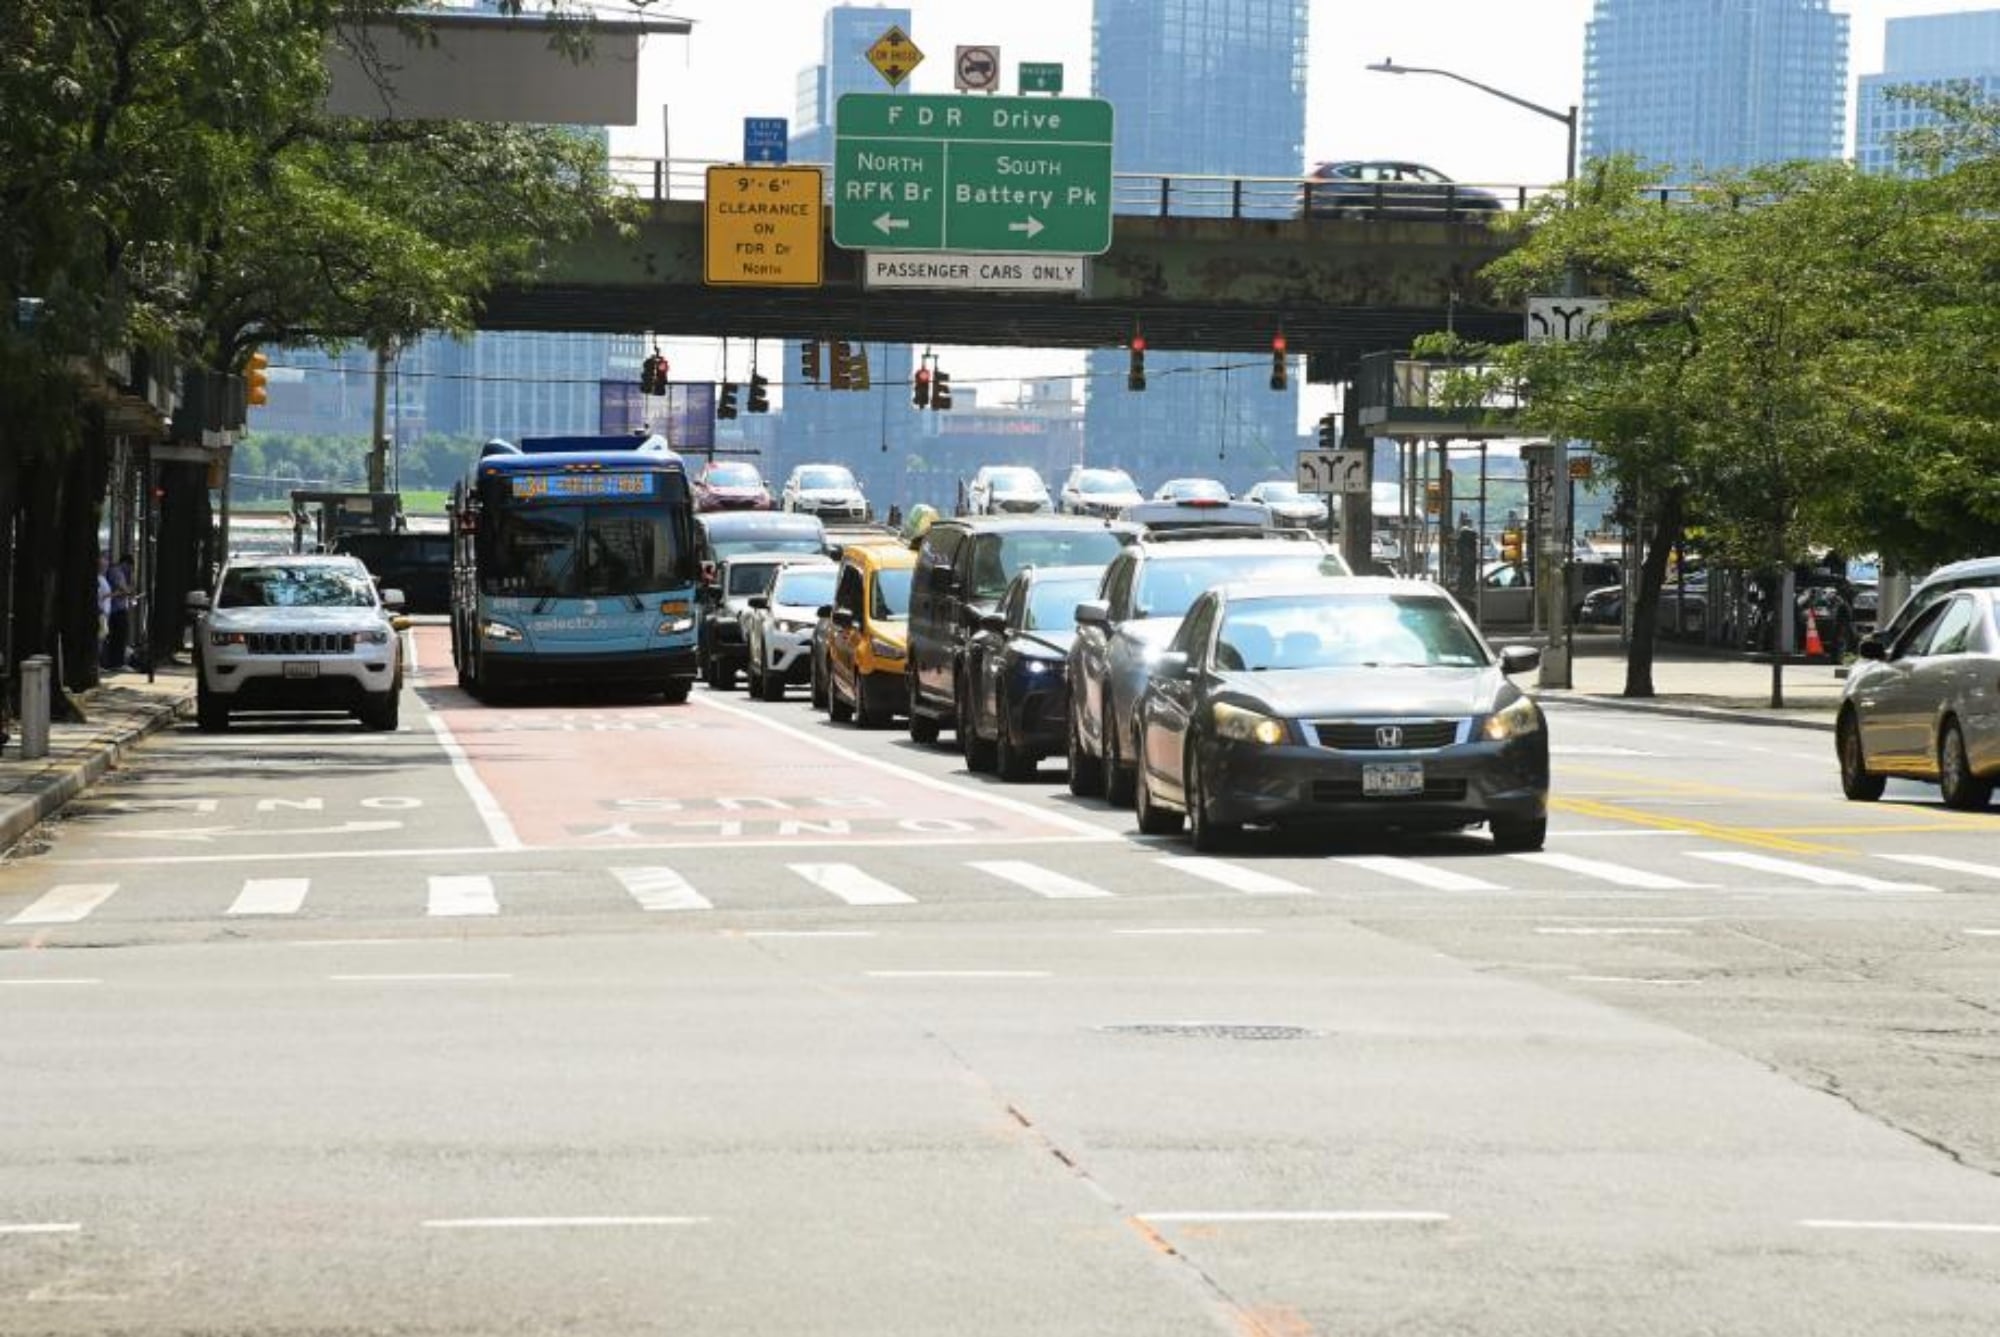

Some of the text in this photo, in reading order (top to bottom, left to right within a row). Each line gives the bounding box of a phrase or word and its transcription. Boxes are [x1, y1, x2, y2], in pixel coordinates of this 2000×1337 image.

[993, 110, 1061, 129] Drive
[857, 152, 923, 172] NORTH
[997, 157, 1061, 175] SOUTH
[846, 182, 932, 201] RFK Br
[956, 184, 1097, 209] Battery Pk
[719, 202, 809, 216] CLEARANCE
[753, 223, 775, 235] ON
[736, 242, 791, 255] FDR Dr
[877, 262, 1075, 280] PASSENGER CARS ONLY
[592, 817, 974, 837] ONLY
